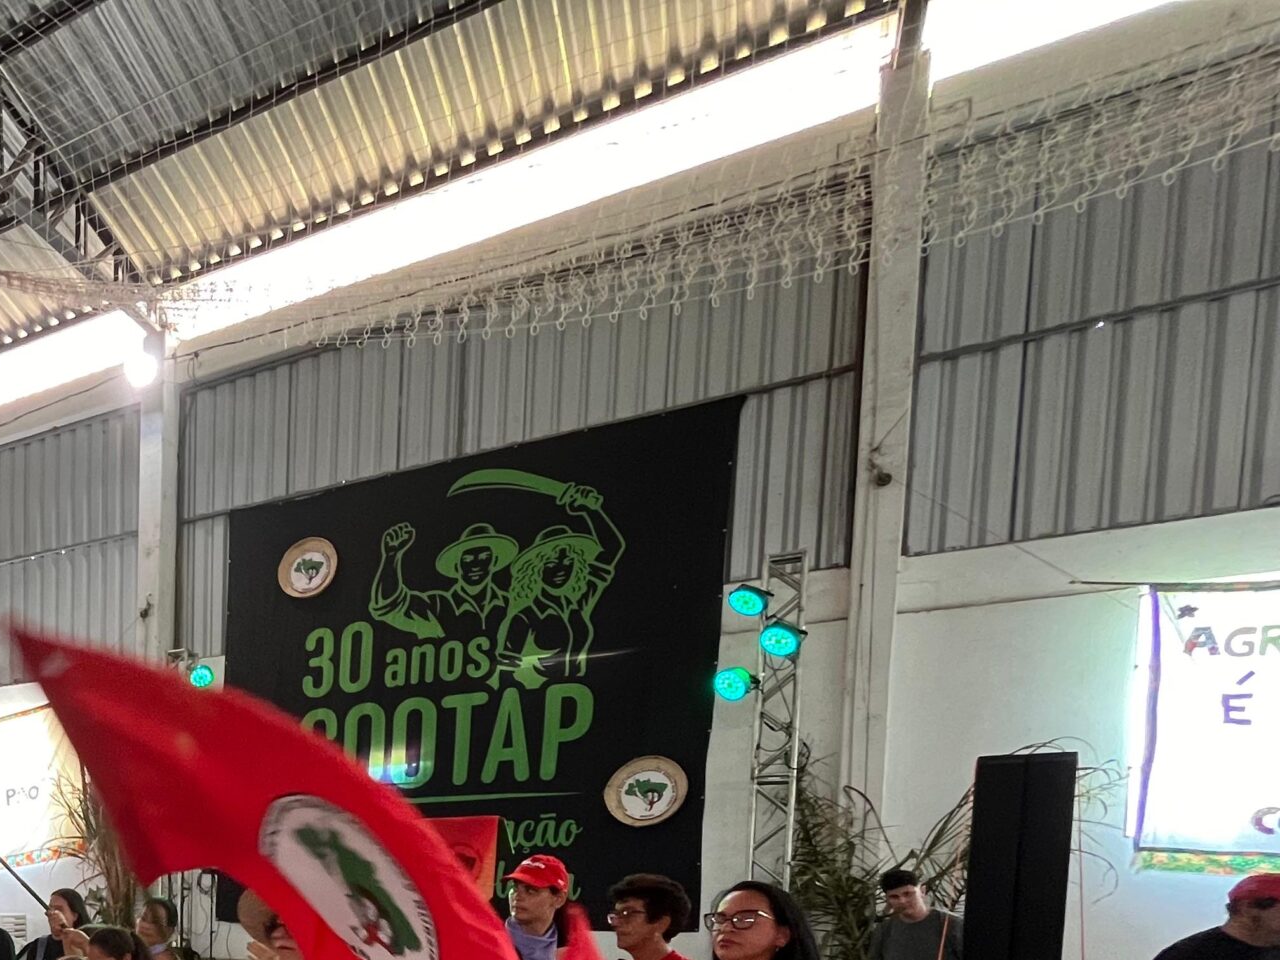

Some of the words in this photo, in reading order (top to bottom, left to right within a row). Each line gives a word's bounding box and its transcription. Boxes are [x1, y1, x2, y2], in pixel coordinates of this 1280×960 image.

[302, 621, 374, 698] 30
[384, 636, 491, 688] anos
[1221, 670, 1255, 725] É
